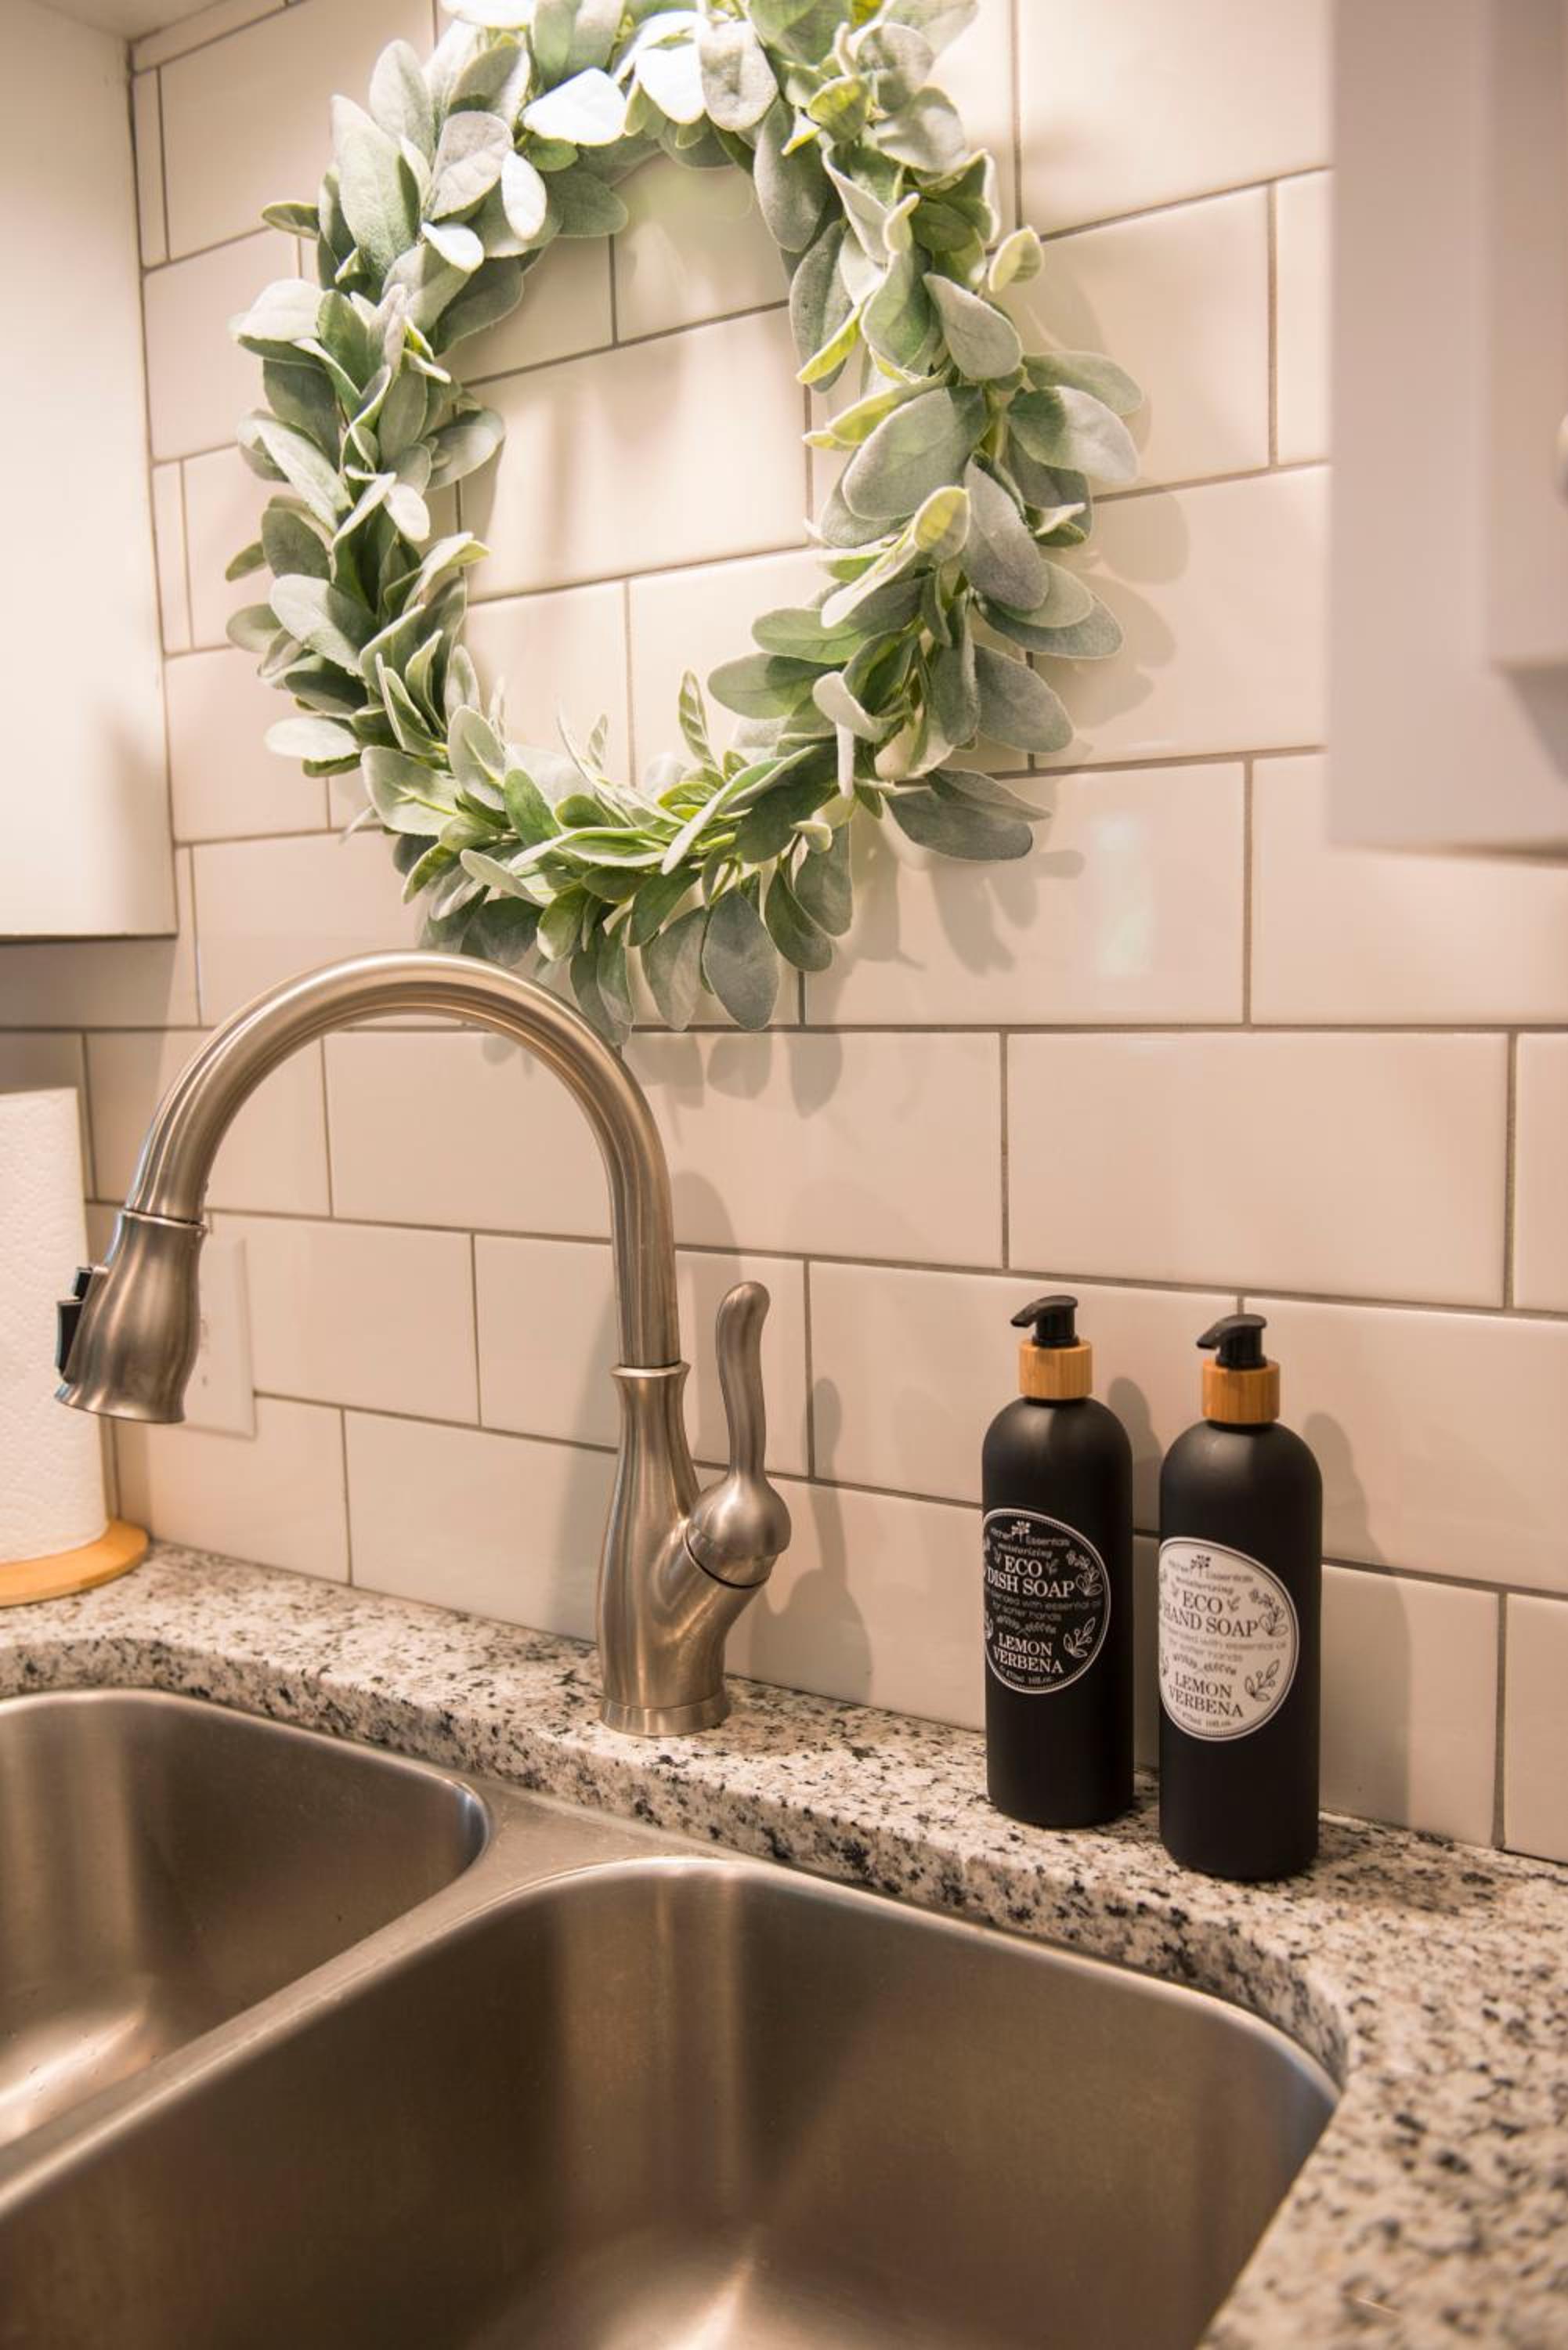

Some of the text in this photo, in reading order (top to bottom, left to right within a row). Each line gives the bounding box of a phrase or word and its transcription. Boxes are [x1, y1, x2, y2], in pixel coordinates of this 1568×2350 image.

[1005, 1555, 1042, 1578] ECO
[988, 1566, 1075, 1597] DISH SOAP
[1183, 1591, 1223, 1614] ECO
[1165, 1603, 1258, 1638] HAND SOAP
[999, 1632, 1053, 1656] LEMON
[992, 1645, 1064, 1674] VERBENA
[1176, 1672, 1232, 1698] LEMON
[1169, 1685, 1244, 1718] VERBENA
